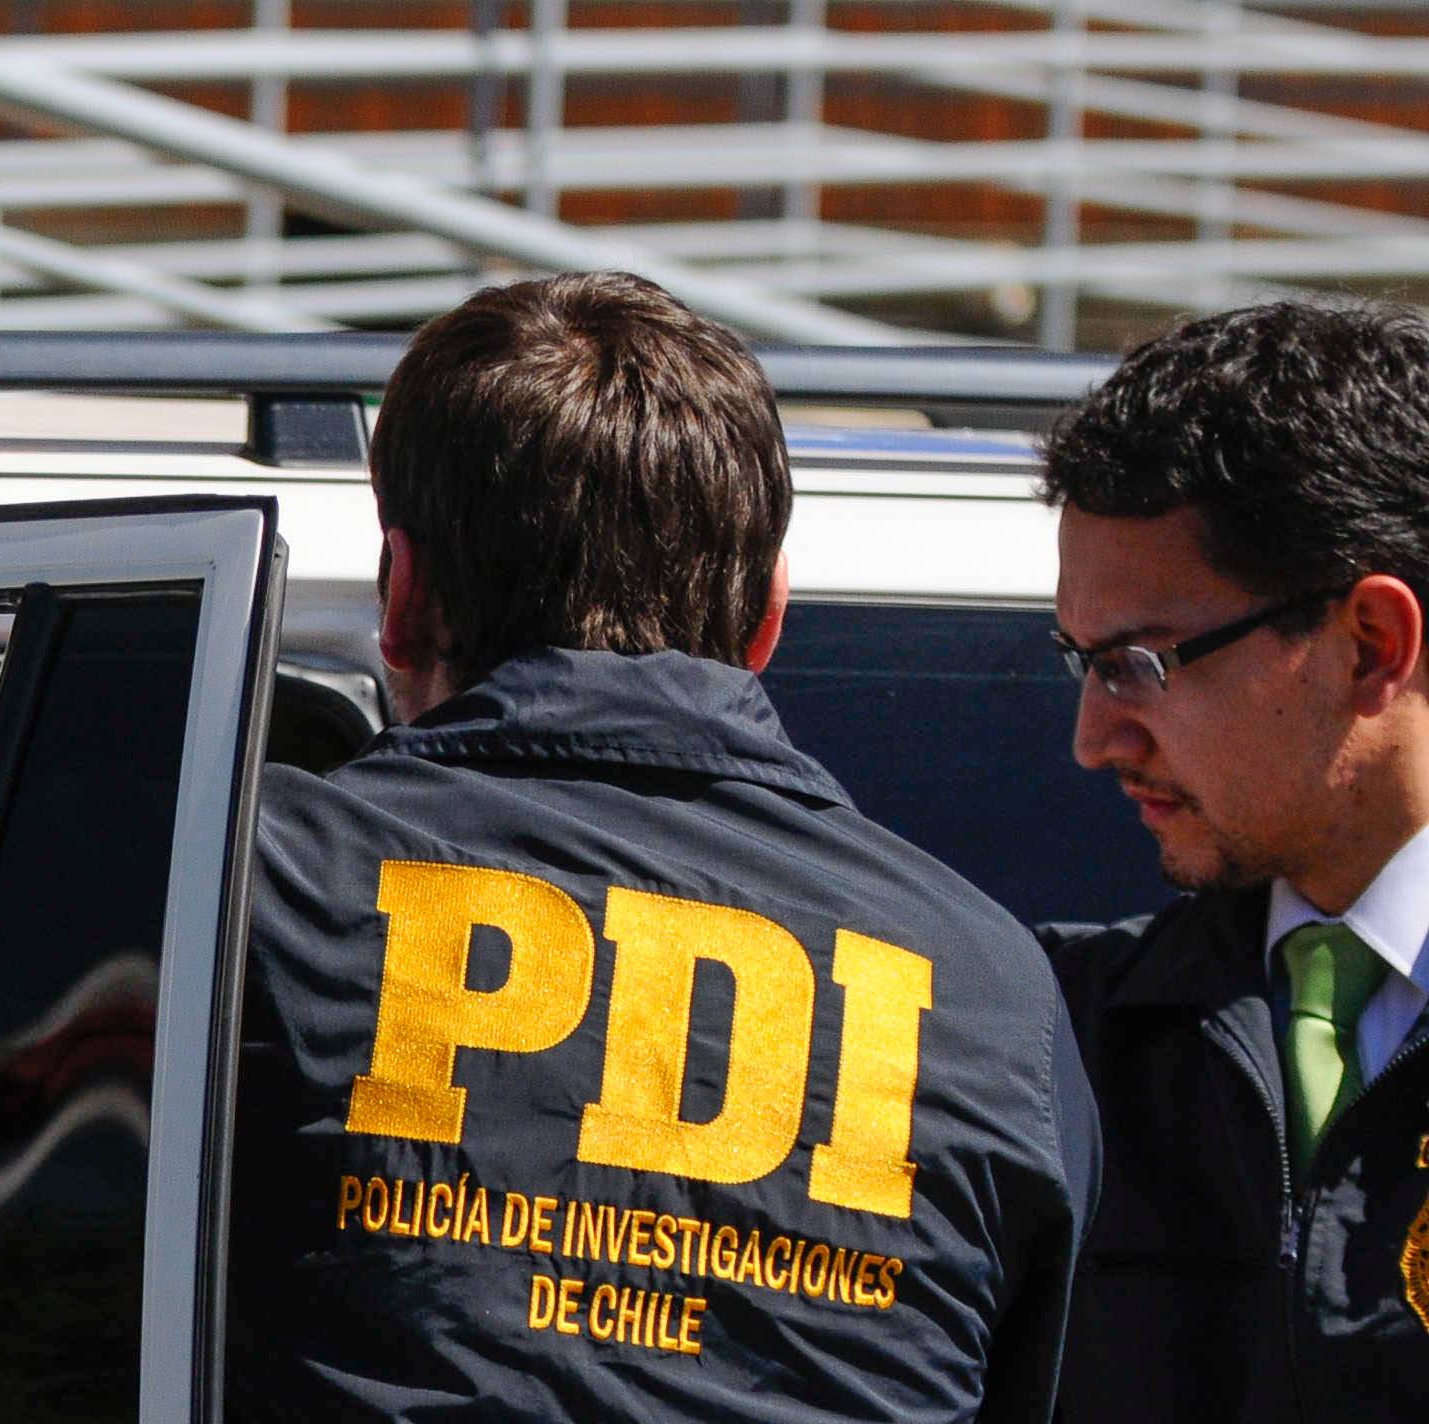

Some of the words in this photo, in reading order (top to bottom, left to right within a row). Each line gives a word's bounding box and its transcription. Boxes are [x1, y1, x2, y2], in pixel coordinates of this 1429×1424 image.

[345, 859, 933, 1219] PDI
[337, 1172, 490, 1246] POLICÍA
[500, 1192, 559, 1256] DE
[562, 1200, 903, 1311] INVESTIGACIONES
[527, 1275, 582, 1336] DE
[588, 1283, 708, 1355] CHILE
